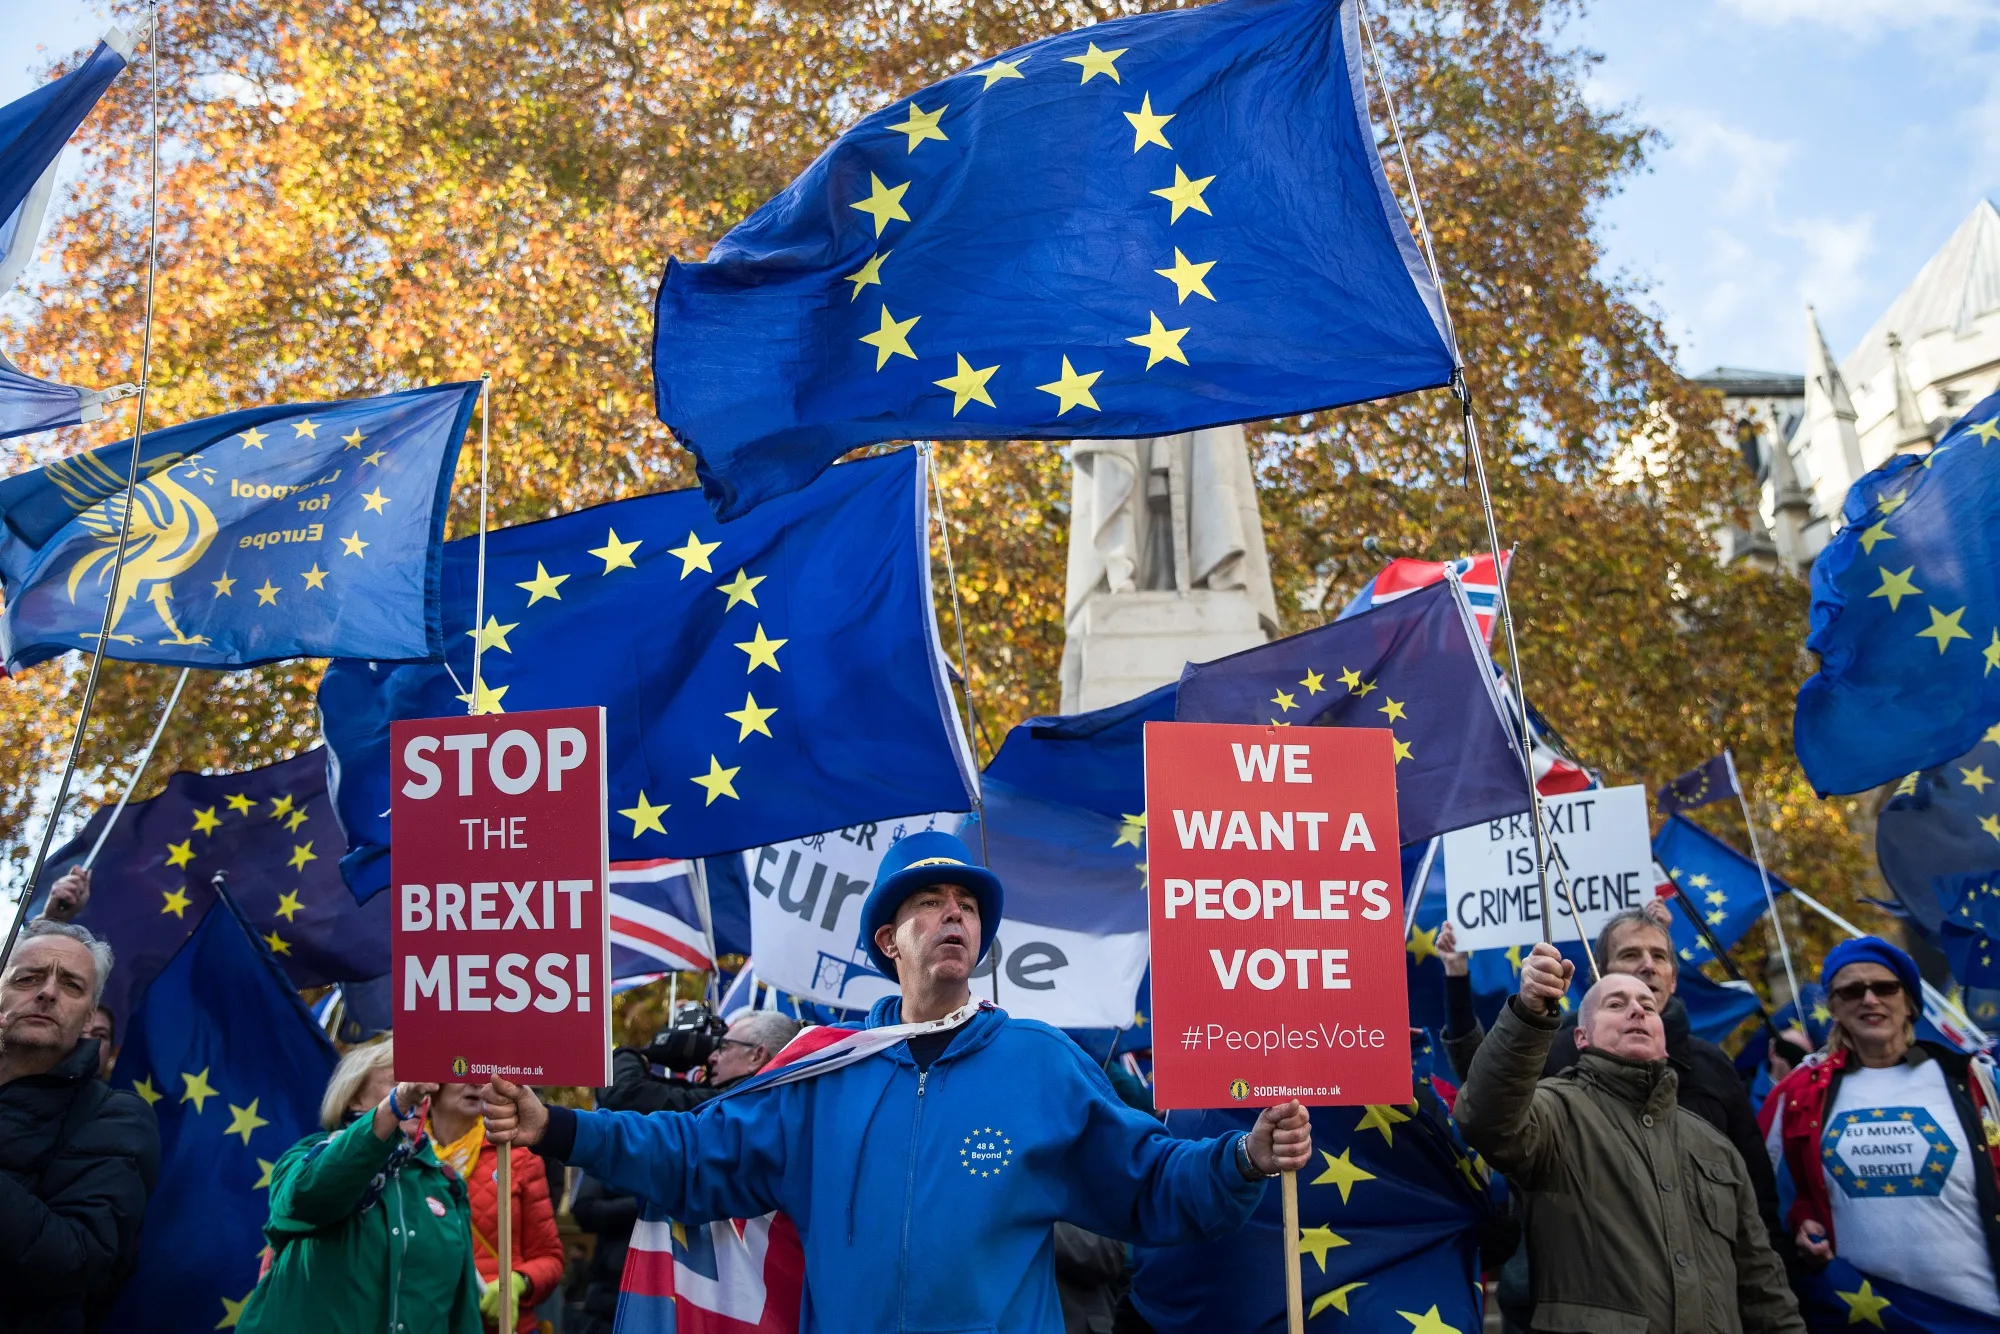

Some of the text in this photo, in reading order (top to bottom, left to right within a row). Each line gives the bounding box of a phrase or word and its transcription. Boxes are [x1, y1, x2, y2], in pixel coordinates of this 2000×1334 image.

[401, 727, 588, 800] STOP
[1231, 743, 1313, 784] WE
[459, 816, 528, 850] THE
[1172, 809, 1377, 852] WANT A
[1506, 842, 1570, 876] IS A
[401, 879, 593, 932] BREXIT
[1164, 878, 1391, 921] PEOPLE'S
[1456, 872, 1641, 929] CRIME SCENE
[403, 953, 591, 1013] MESS!
[1208, 948, 1351, 990] VOTE
[1180, 1022, 1385, 1056] #PeoplesVote
[470, 1063, 544, 1076] SODEMaction.co.uk
[1253, 1085, 1341, 1097] SODEMaction.co.uk
[976, 1142, 996, 1150] 48 &
[1846, 1124, 1915, 1137] EU MUMS
[971, 1151, 1002, 1160] Beyond
[1850, 1143, 1914, 1156] AGAINST
